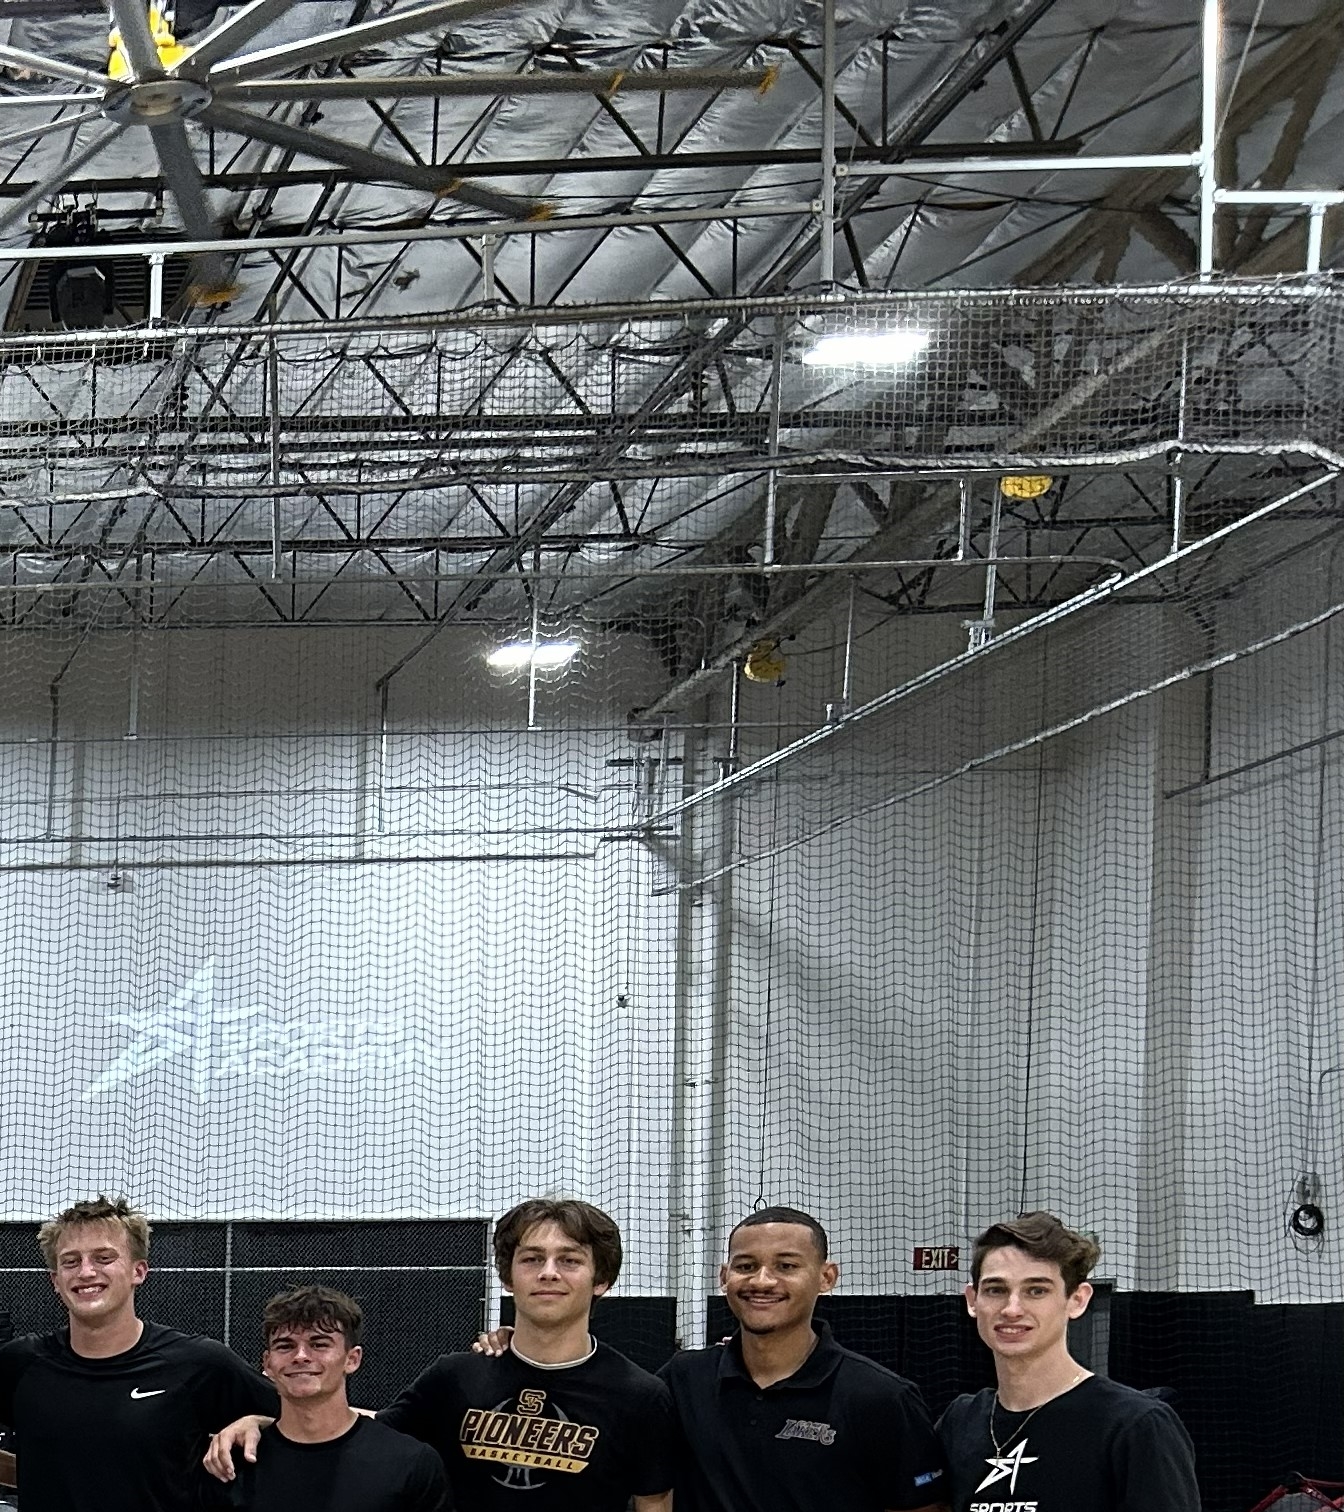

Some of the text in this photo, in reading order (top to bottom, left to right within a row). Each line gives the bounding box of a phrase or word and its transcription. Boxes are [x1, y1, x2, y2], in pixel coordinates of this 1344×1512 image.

[921, 1248, 951, 1269] EXIT
[459, 1407, 600, 1459] PIONEERS
[469, 1448, 575, 1470] BASKETBALL
